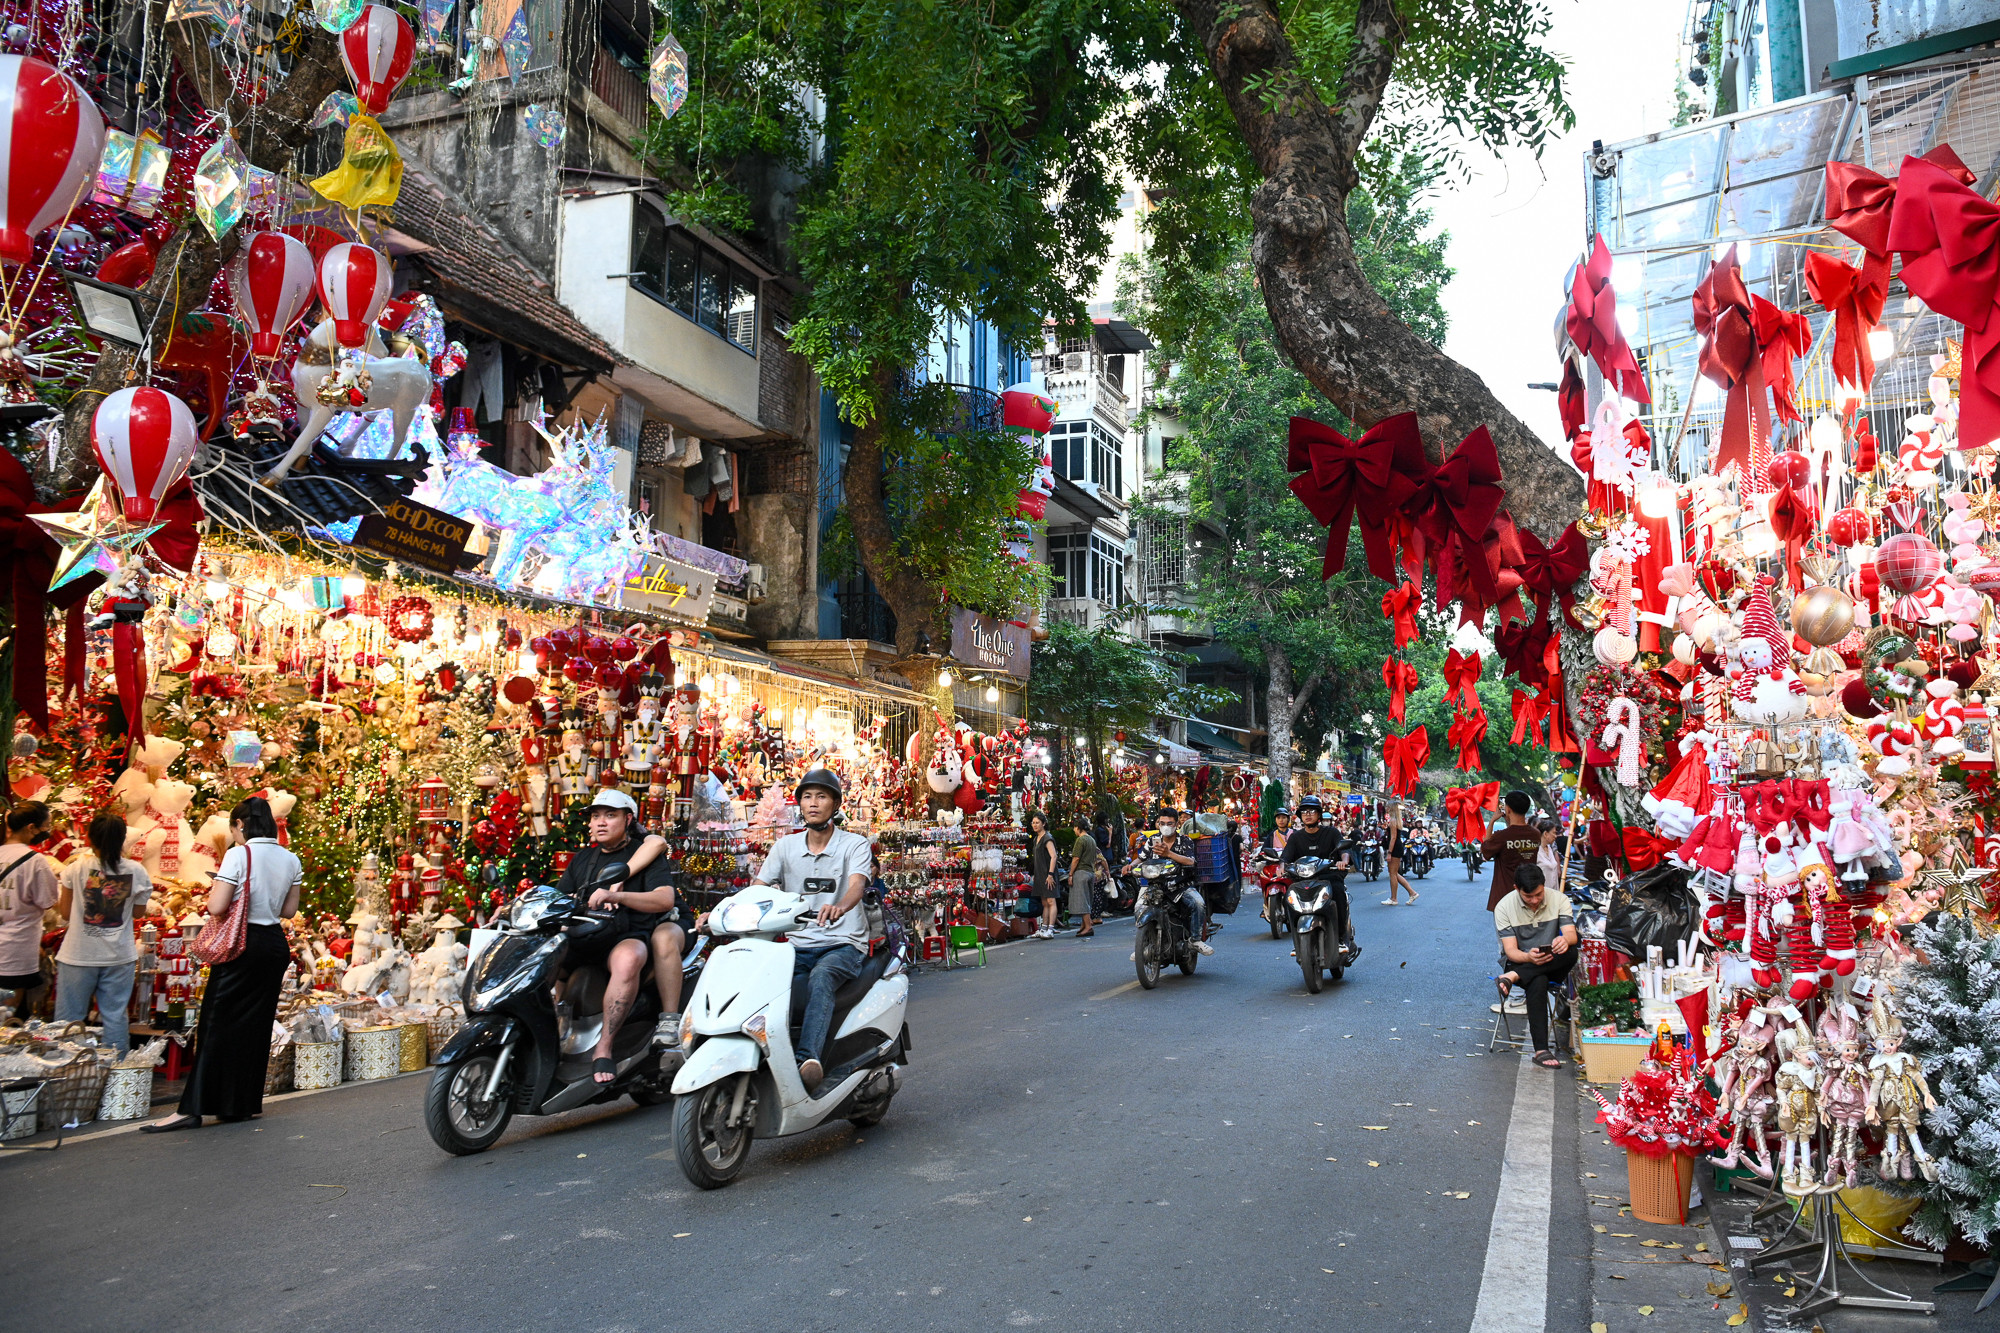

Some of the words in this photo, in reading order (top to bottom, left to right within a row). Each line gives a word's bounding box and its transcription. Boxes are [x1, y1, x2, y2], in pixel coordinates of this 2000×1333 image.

[385, 526, 399, 540] 78
[971, 619, 992, 651] The
[993, 629, 1015, 658] One
[979, 649, 1006, 667] HOSTEL
